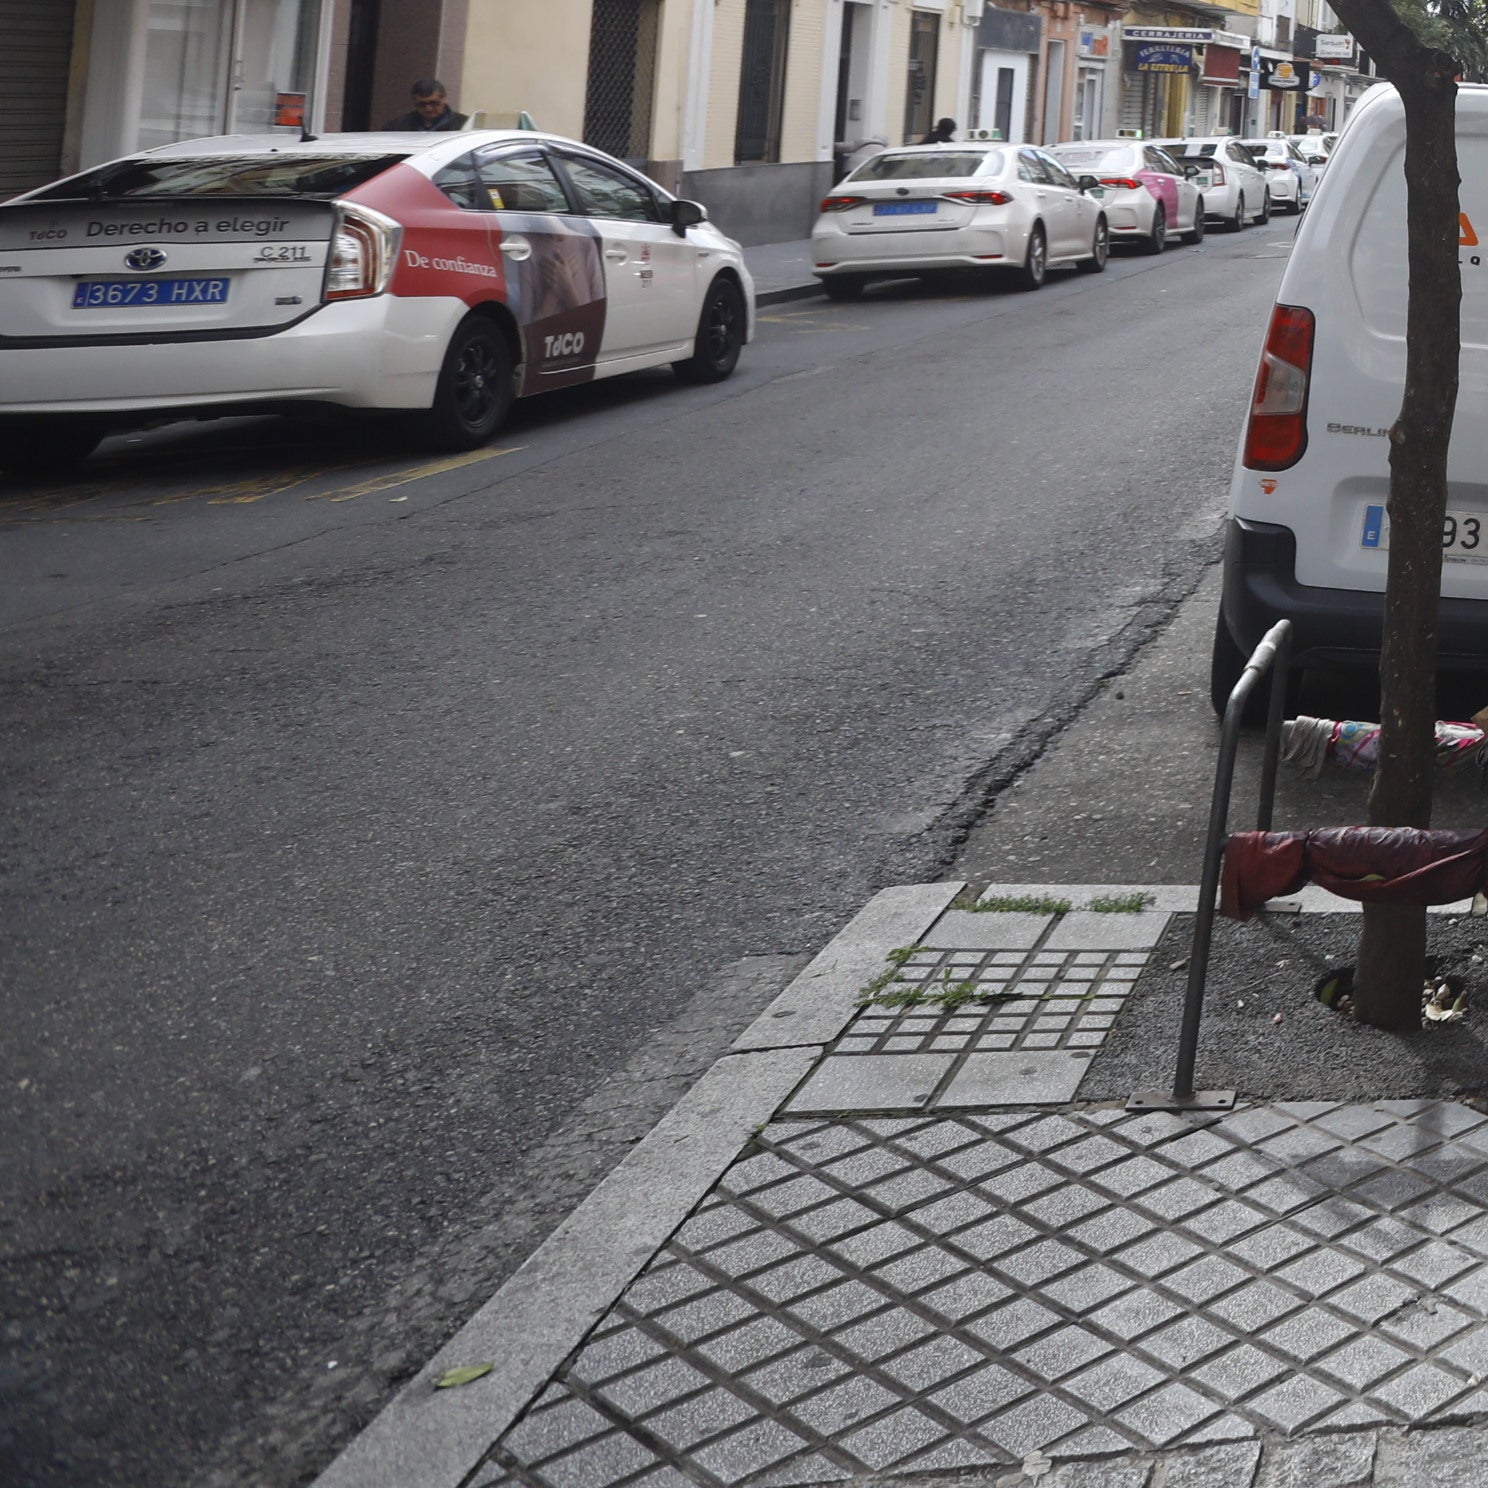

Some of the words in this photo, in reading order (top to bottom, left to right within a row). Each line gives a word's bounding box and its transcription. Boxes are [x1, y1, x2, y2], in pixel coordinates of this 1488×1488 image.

[86, 216, 188, 238] Derecho
[195, 220, 209, 236] a
[216, 216, 290, 237] elegir
[260, 246, 274, 258] C
[279, 246, 307, 259] 211
[405, 250, 428, 269] De
[434, 256, 498, 278] confianza
[89, 283, 158, 305] 3673
[171, 280, 223, 301] HXR
[1442, 518, 1480, 550] 93
